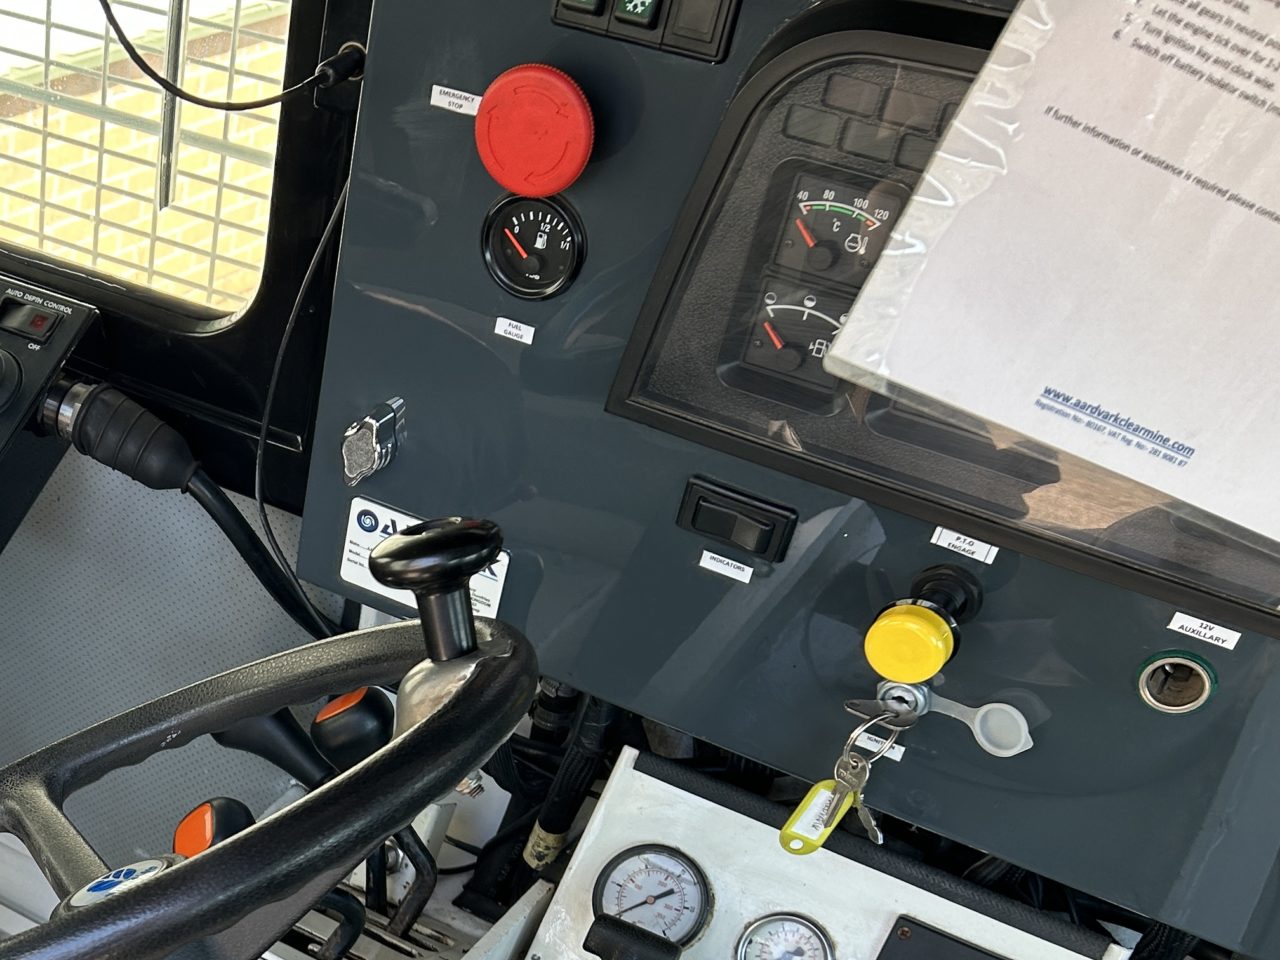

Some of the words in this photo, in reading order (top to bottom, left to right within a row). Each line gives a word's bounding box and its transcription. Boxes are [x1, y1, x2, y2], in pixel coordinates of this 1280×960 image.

[1152, 4, 1168, 17] Let
[1167, 12, 1183, 26] the
[1183, 21, 1213, 40] engine
[1229, 43, 1251, 57] over
[1250, 49, 1266, 63] for
[1233, 22, 1268, 42] neutral
[1142, 21, 1163, 38] Turn
[1195, 46, 1212, 62] key
[1230, 65, 1253, 80] clock
[1130, 37, 1160, 58] Switch
[1159, 53, 1175, 65] off
[1172, 58, 1206, 81] battery
[1238, 90, 1268, 109] switch
[439, 89, 475, 103] EMERGENCY
[448, 100, 463, 110] STOP
[1044, 105, 1054, 116] If
[1051, 108, 1082, 130] further
[1081, 123, 1131, 153] information
[1130, 147, 1142, 158] or
[1141, 152, 1185, 178] assistance
[1182, 170, 1193, 181] is
[1191, 176, 1230, 199] required
[1226, 191, 1256, 211] please
[797, 190, 809, 200] 40
[823, 189, 835, 200] 80
[853, 198, 869, 209] 100
[874, 209, 890, 220] 120
[513, 226, 520, 234] 0
[540, 223, 551, 232] 1/2
[560, 241, 570, 250] 1/1
[5, 288, 24, 298] AUTO
[24, 293, 44, 304] DEPTH
[44, 300, 73, 315] CONTROL
[508, 322, 522, 331] FUEL
[503, 329, 524, 340] GAUGE
[27, 343, 41, 351] OFF
[1035, 398, 1071, 418] Registration
[1043, 386, 1195, 457] www.aardvarkclearmine.com
[948, 542, 976, 556] ENGAGE
[709, 555, 745, 572] INDICATORS
[1199, 622, 1215, 631] 12V
[1178, 624, 1227, 645] AUXILLARY
[867, 735, 896, 750] IGNITN
